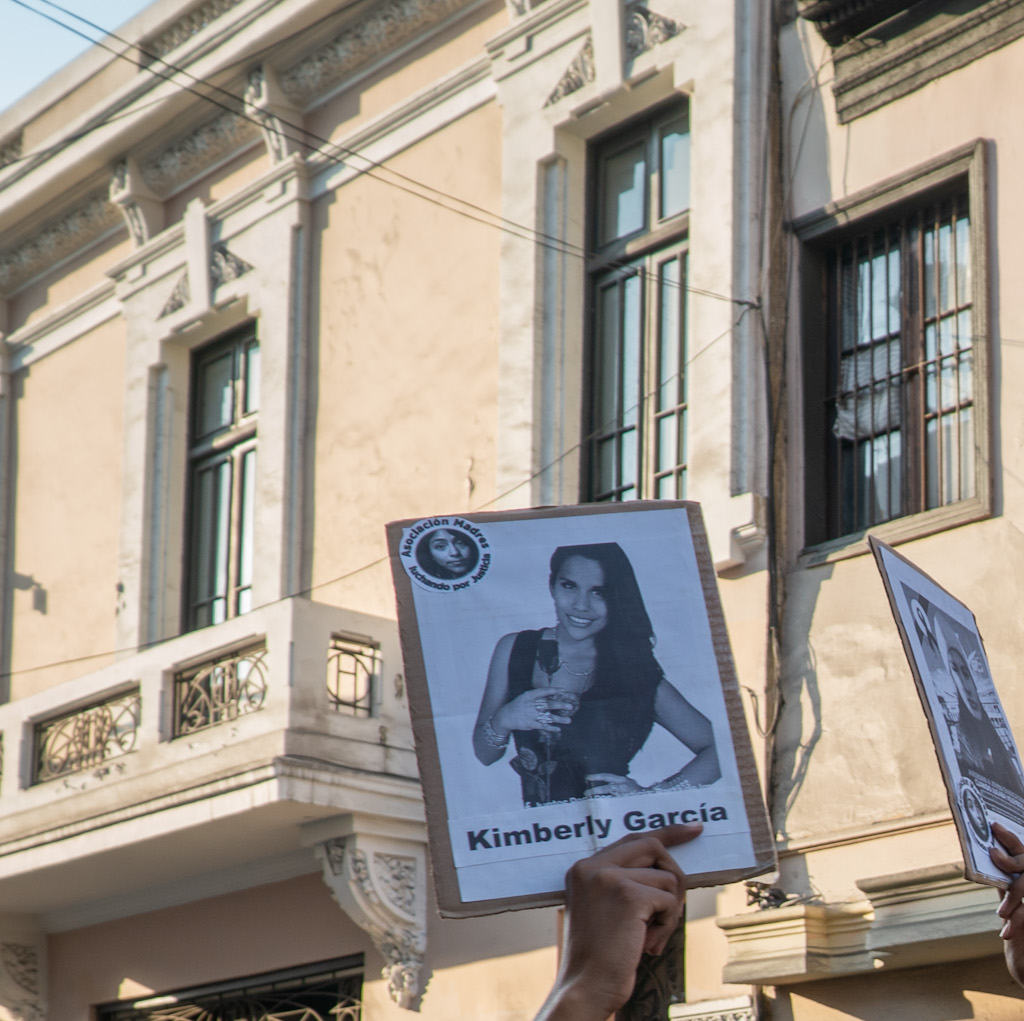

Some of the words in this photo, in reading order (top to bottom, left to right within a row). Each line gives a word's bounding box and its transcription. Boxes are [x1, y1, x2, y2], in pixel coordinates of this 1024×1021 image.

[401, 518, 449, 558] Asociación
[453, 519, 489, 549] Madres
[408, 565, 450, 591] luchando
[452, 581, 470, 591] por
[466, 814, 612, 851] Kimberly
[623, 803, 728, 832] García
